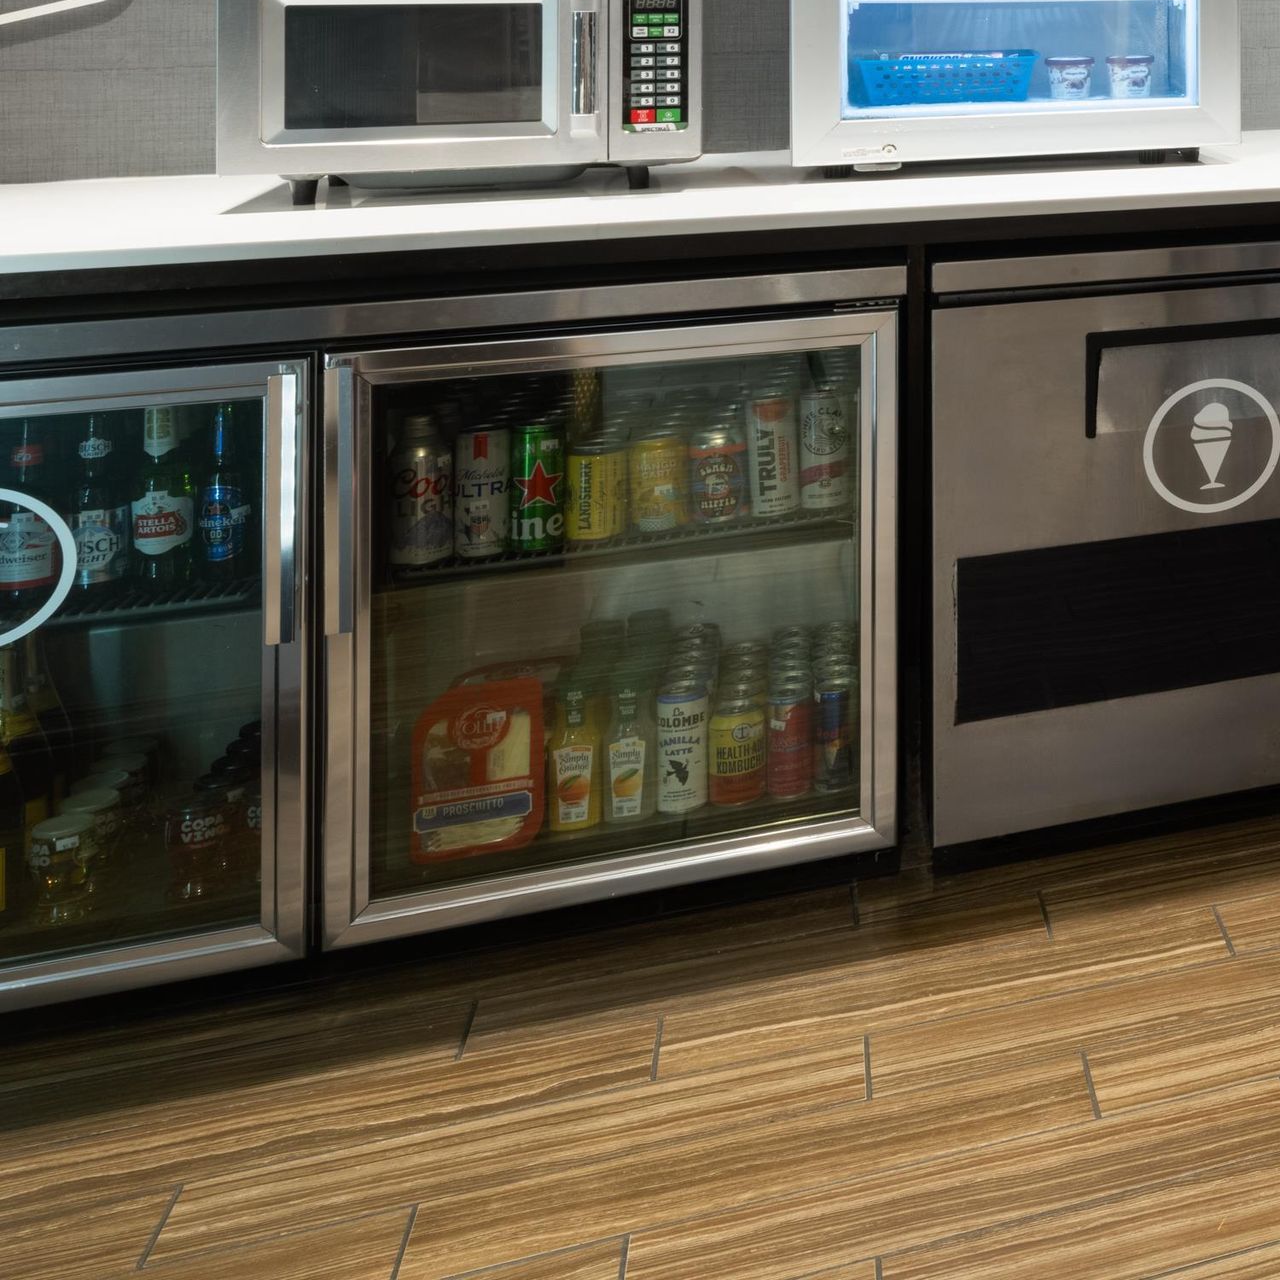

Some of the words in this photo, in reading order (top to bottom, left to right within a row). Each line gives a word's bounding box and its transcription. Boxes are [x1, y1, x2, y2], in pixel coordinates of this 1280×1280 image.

[757, 428, 777, 497] TRULY
[578, 462, 593, 532] LANDSHARK
[137, 517, 176, 526] STELLA
[137, 524, 177, 534] ARTOIS
[664, 746, 694, 757] LATTE
